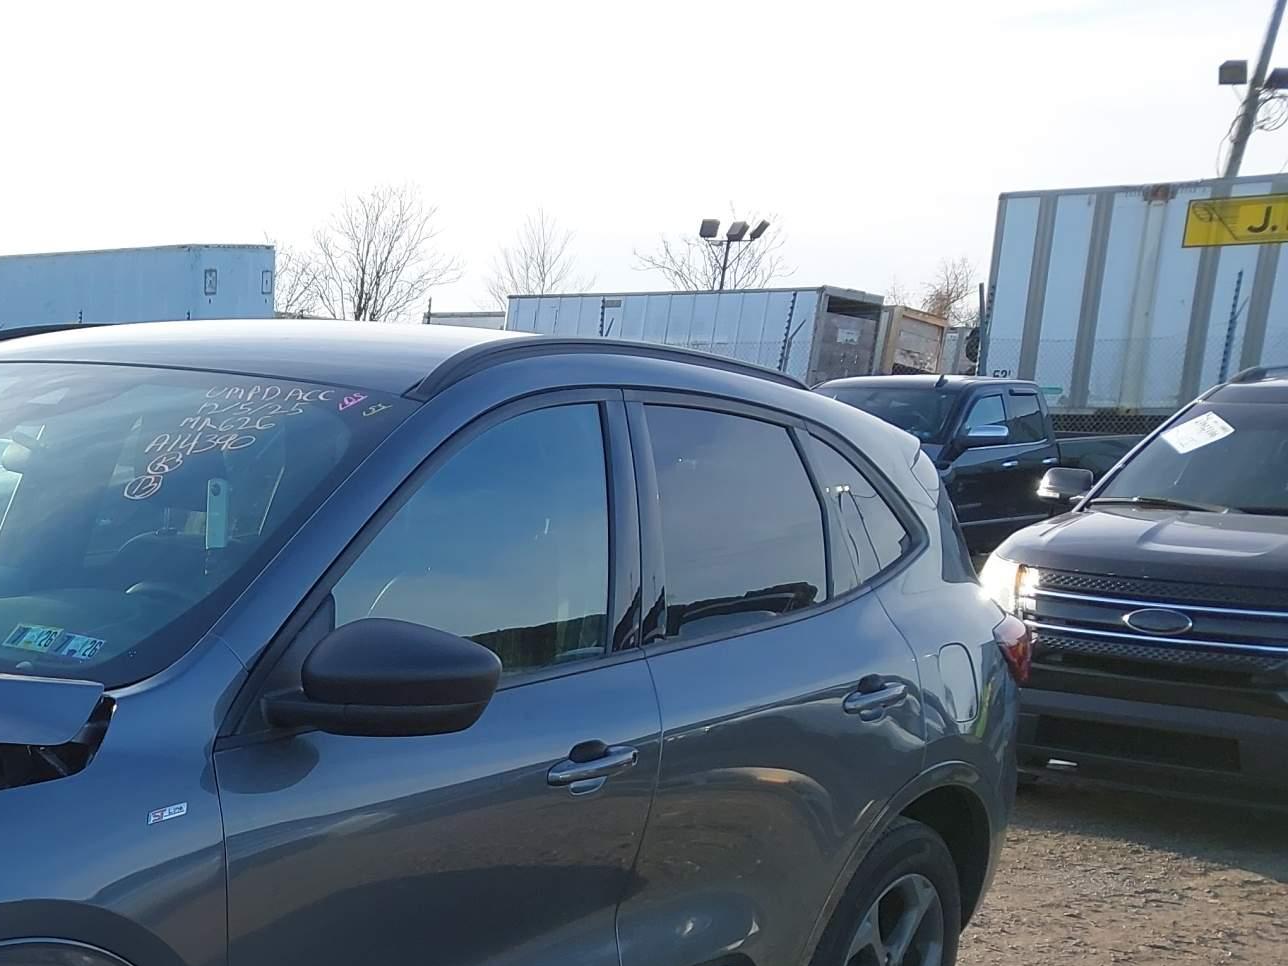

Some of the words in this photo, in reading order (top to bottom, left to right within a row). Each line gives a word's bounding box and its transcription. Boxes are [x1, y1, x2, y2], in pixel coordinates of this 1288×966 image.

[1247, 205, 1288, 233] J.
[285, 387, 335, 401] ACC
[196, 401, 310, 416] 12/5/25
[81, 639, 104, 658] 26
